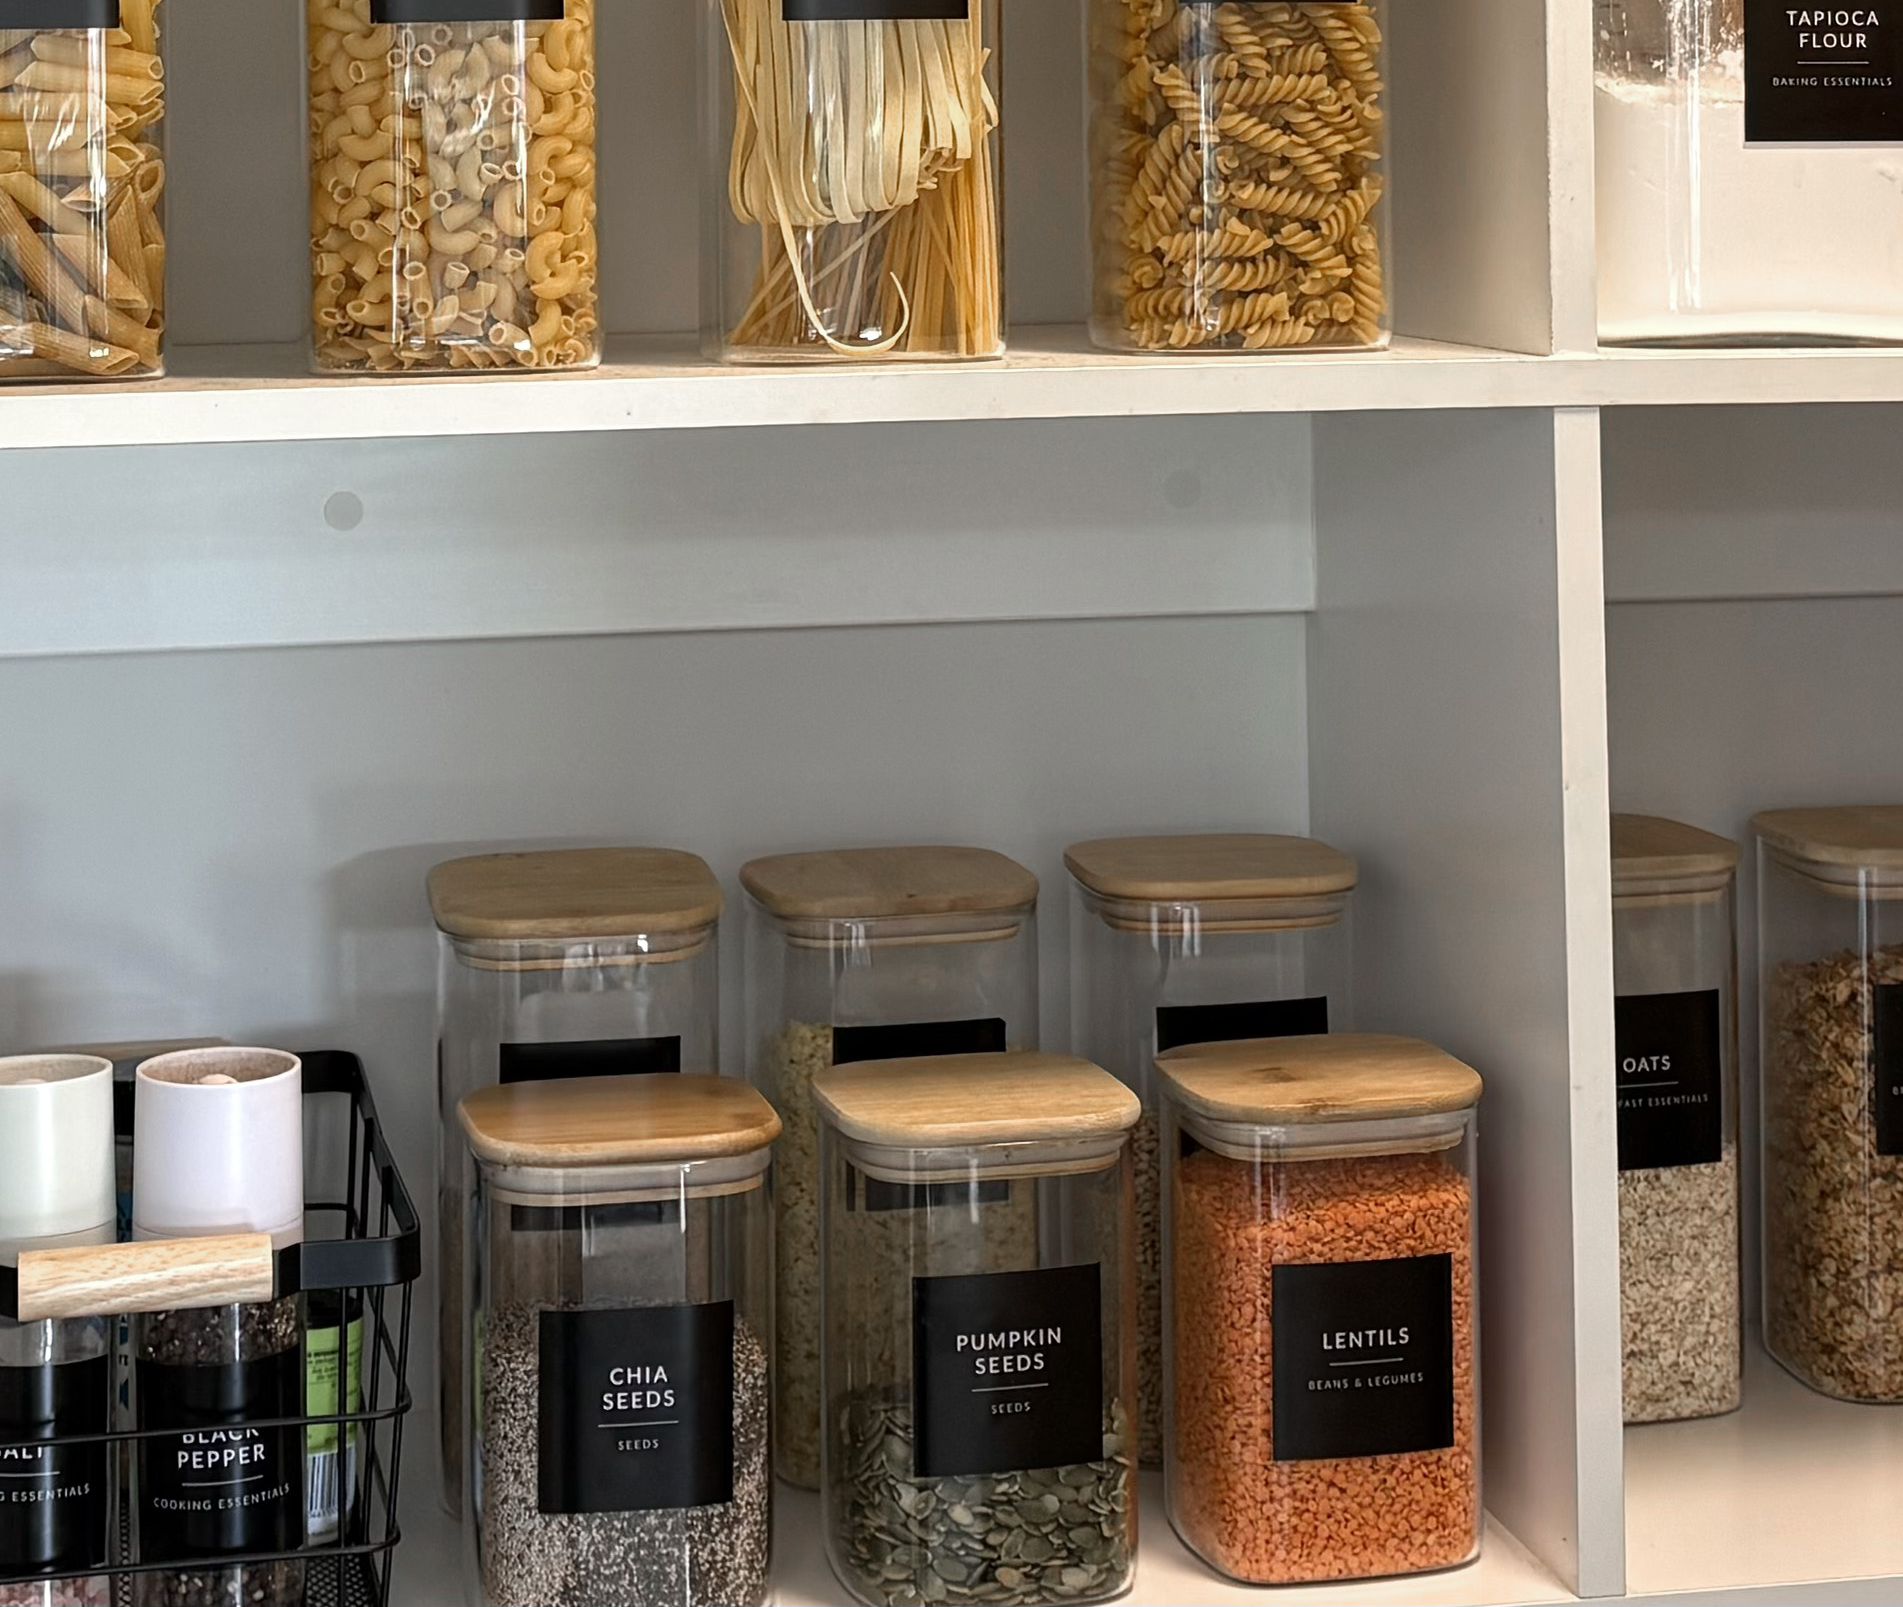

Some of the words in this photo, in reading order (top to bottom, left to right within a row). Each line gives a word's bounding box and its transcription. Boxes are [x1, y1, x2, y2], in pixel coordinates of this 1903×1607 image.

[1786, 10, 1879, 29] TAPIOCA
[1798, 30, 1868, 50] FLOUR
[1772, 75, 1818, 88] BAKING
[1823, 75, 1893, 88] ESSENTIALS
[1623, 1055, 1671, 1074] OATS
[1648, 1093, 1709, 1107] ESSENTIALS
[955, 1326, 1063, 1354] PUMPKIN
[1321, 1326, 1410, 1351] LENTILS
[974, 1350, 1045, 1376] SEEDS
[609, 1366, 669, 1387] CHIA
[1307, 1378, 1350, 1392] BEANS
[1355, 1378, 1363, 1391] &
[1367, 1372, 1424, 1388] LEGUMES
[602, 1387, 677, 1412] SEEDS
[990, 1401, 1031, 1415] SEEDS
[182, 1428, 259, 1445] BLACK
[617, 1437, 661, 1452] SEEDS
[177, 1444, 266, 1469] PEPPER
[12, 1483, 91, 1502] ESSENTIALS
[153, 1497, 213, 1512] COOKING
[218, 1483, 291, 1511] ESSENTIALS
